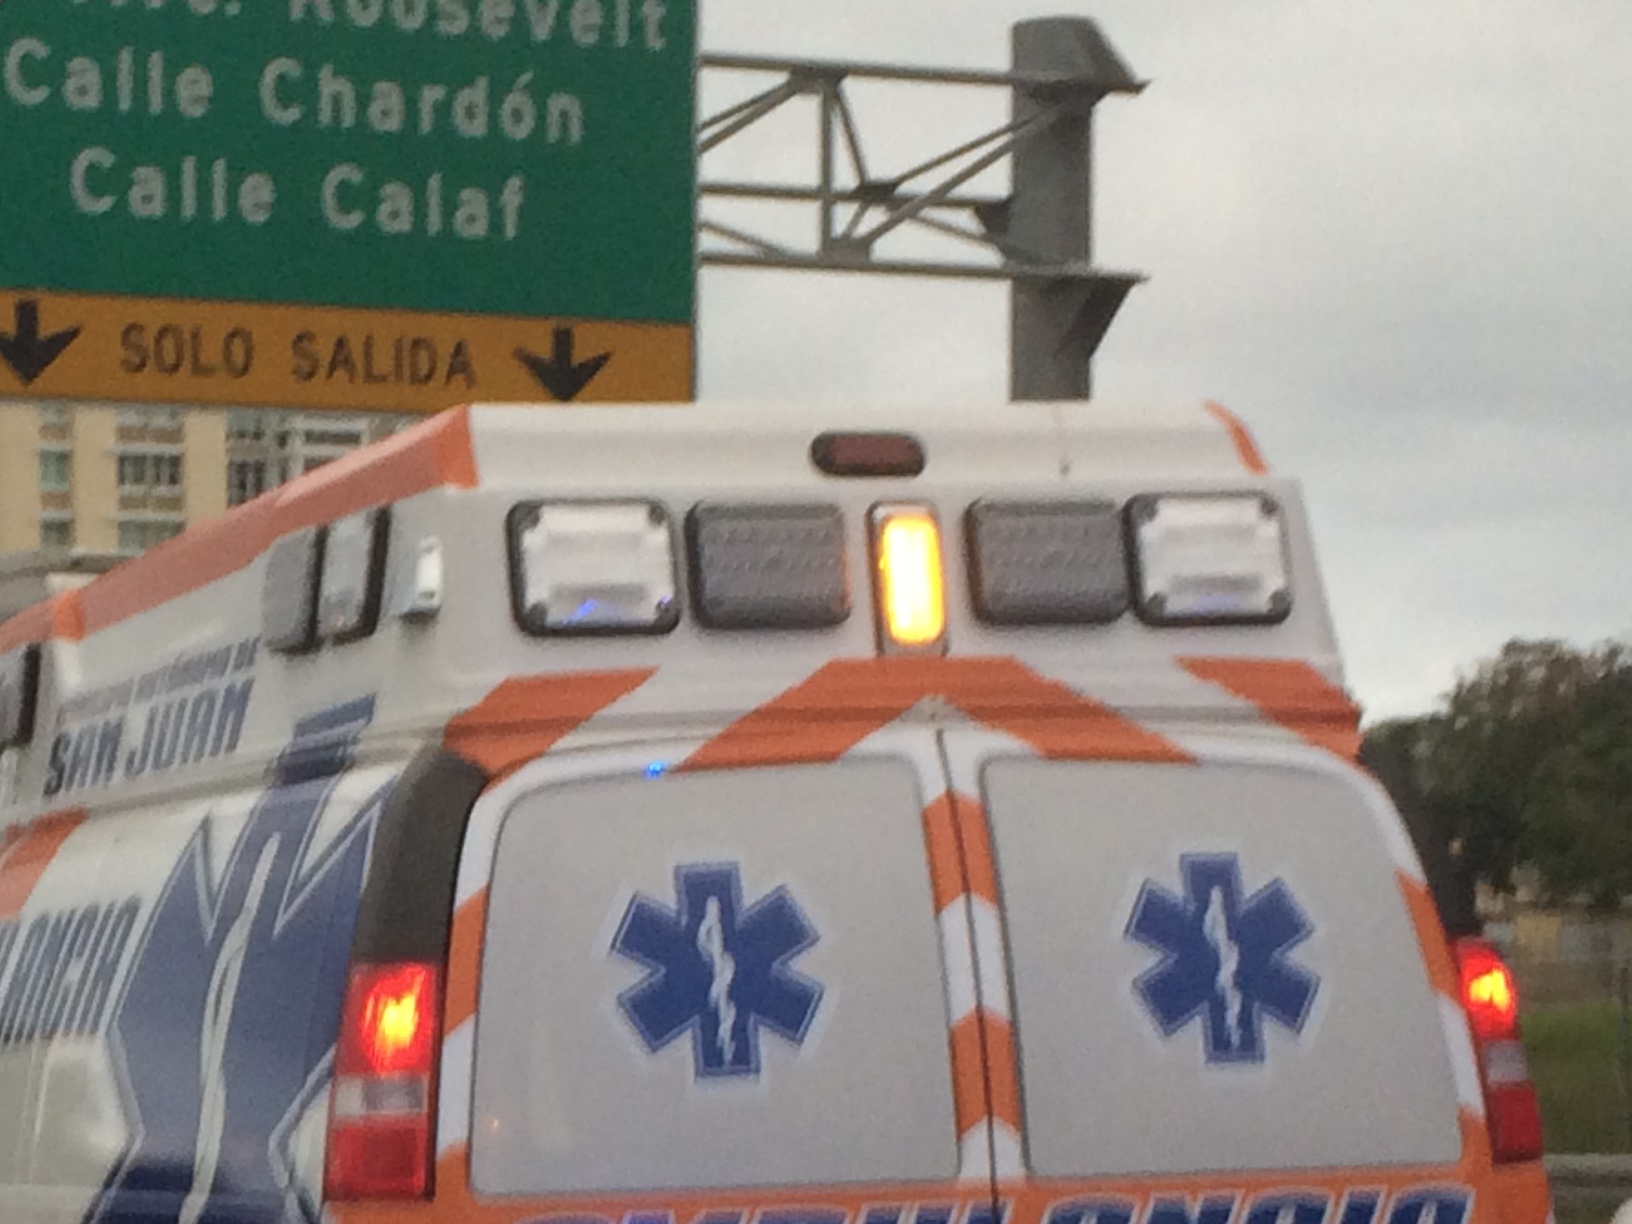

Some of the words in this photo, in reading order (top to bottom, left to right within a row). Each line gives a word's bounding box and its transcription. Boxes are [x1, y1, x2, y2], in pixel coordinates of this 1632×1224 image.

[3, 37, 215, 118] Calle
[260, 57, 586, 145] Chardón
[69, 146, 277, 226] Calle
[321, 163, 528, 241] Calaf
[119, 322, 255, 379] SOLO
[290, 330, 478, 389] SALIDA
[122, 676, 256, 784] JUAN
